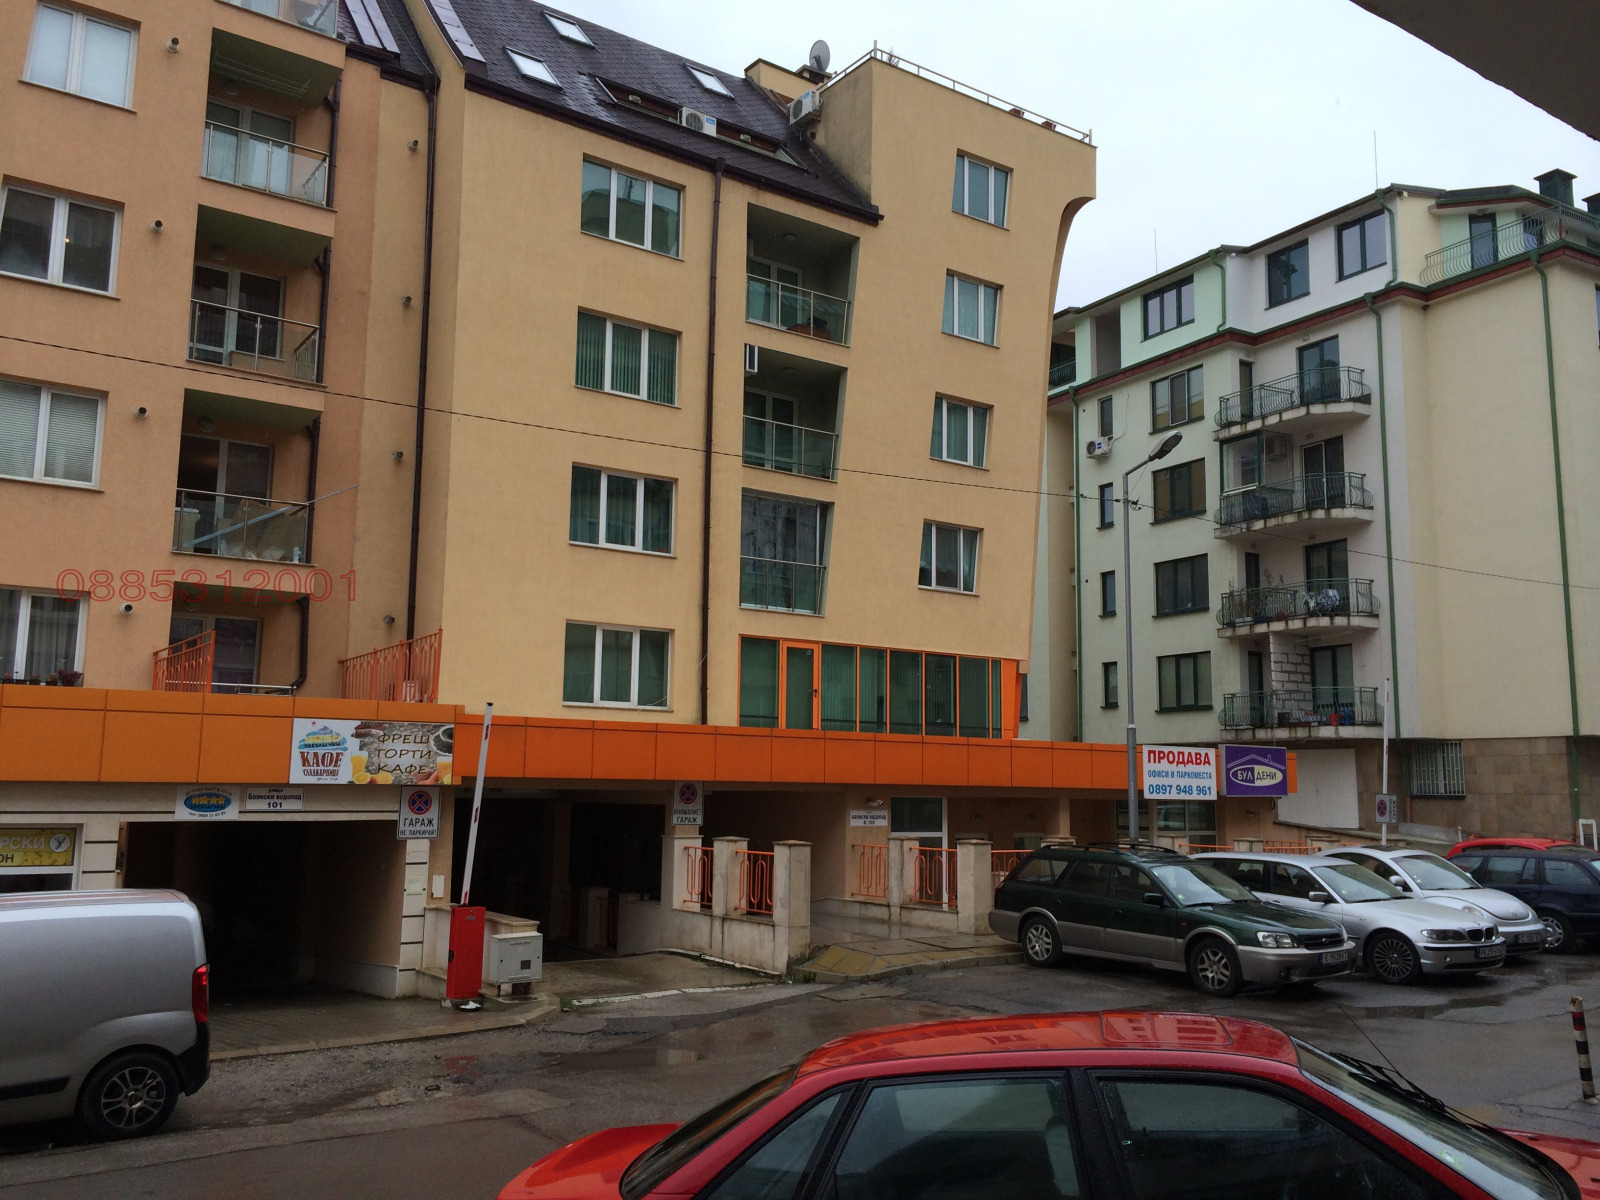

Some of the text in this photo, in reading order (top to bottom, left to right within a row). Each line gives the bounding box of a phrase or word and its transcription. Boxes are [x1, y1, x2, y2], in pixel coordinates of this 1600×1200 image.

[377, 733, 430, 745] ФРЕШ
[300, 751, 344, 767] КАФЕ
[376, 749, 432, 759] ТОРТИ
[1147, 750, 1211, 767] ПРОДАВА
[377, 764, 428, 775] КАФЕ
[1147, 769, 1169, 779] ОФИСИ
[1176, 770, 1212, 780] ПАРКОМЕСТА
[1237, 769, 1277, 782] БУЛ ДЕНИ
[1148, 784, 1212, 796] 0897 948 961
[403, 818, 435, 827] ГАРАЖ
